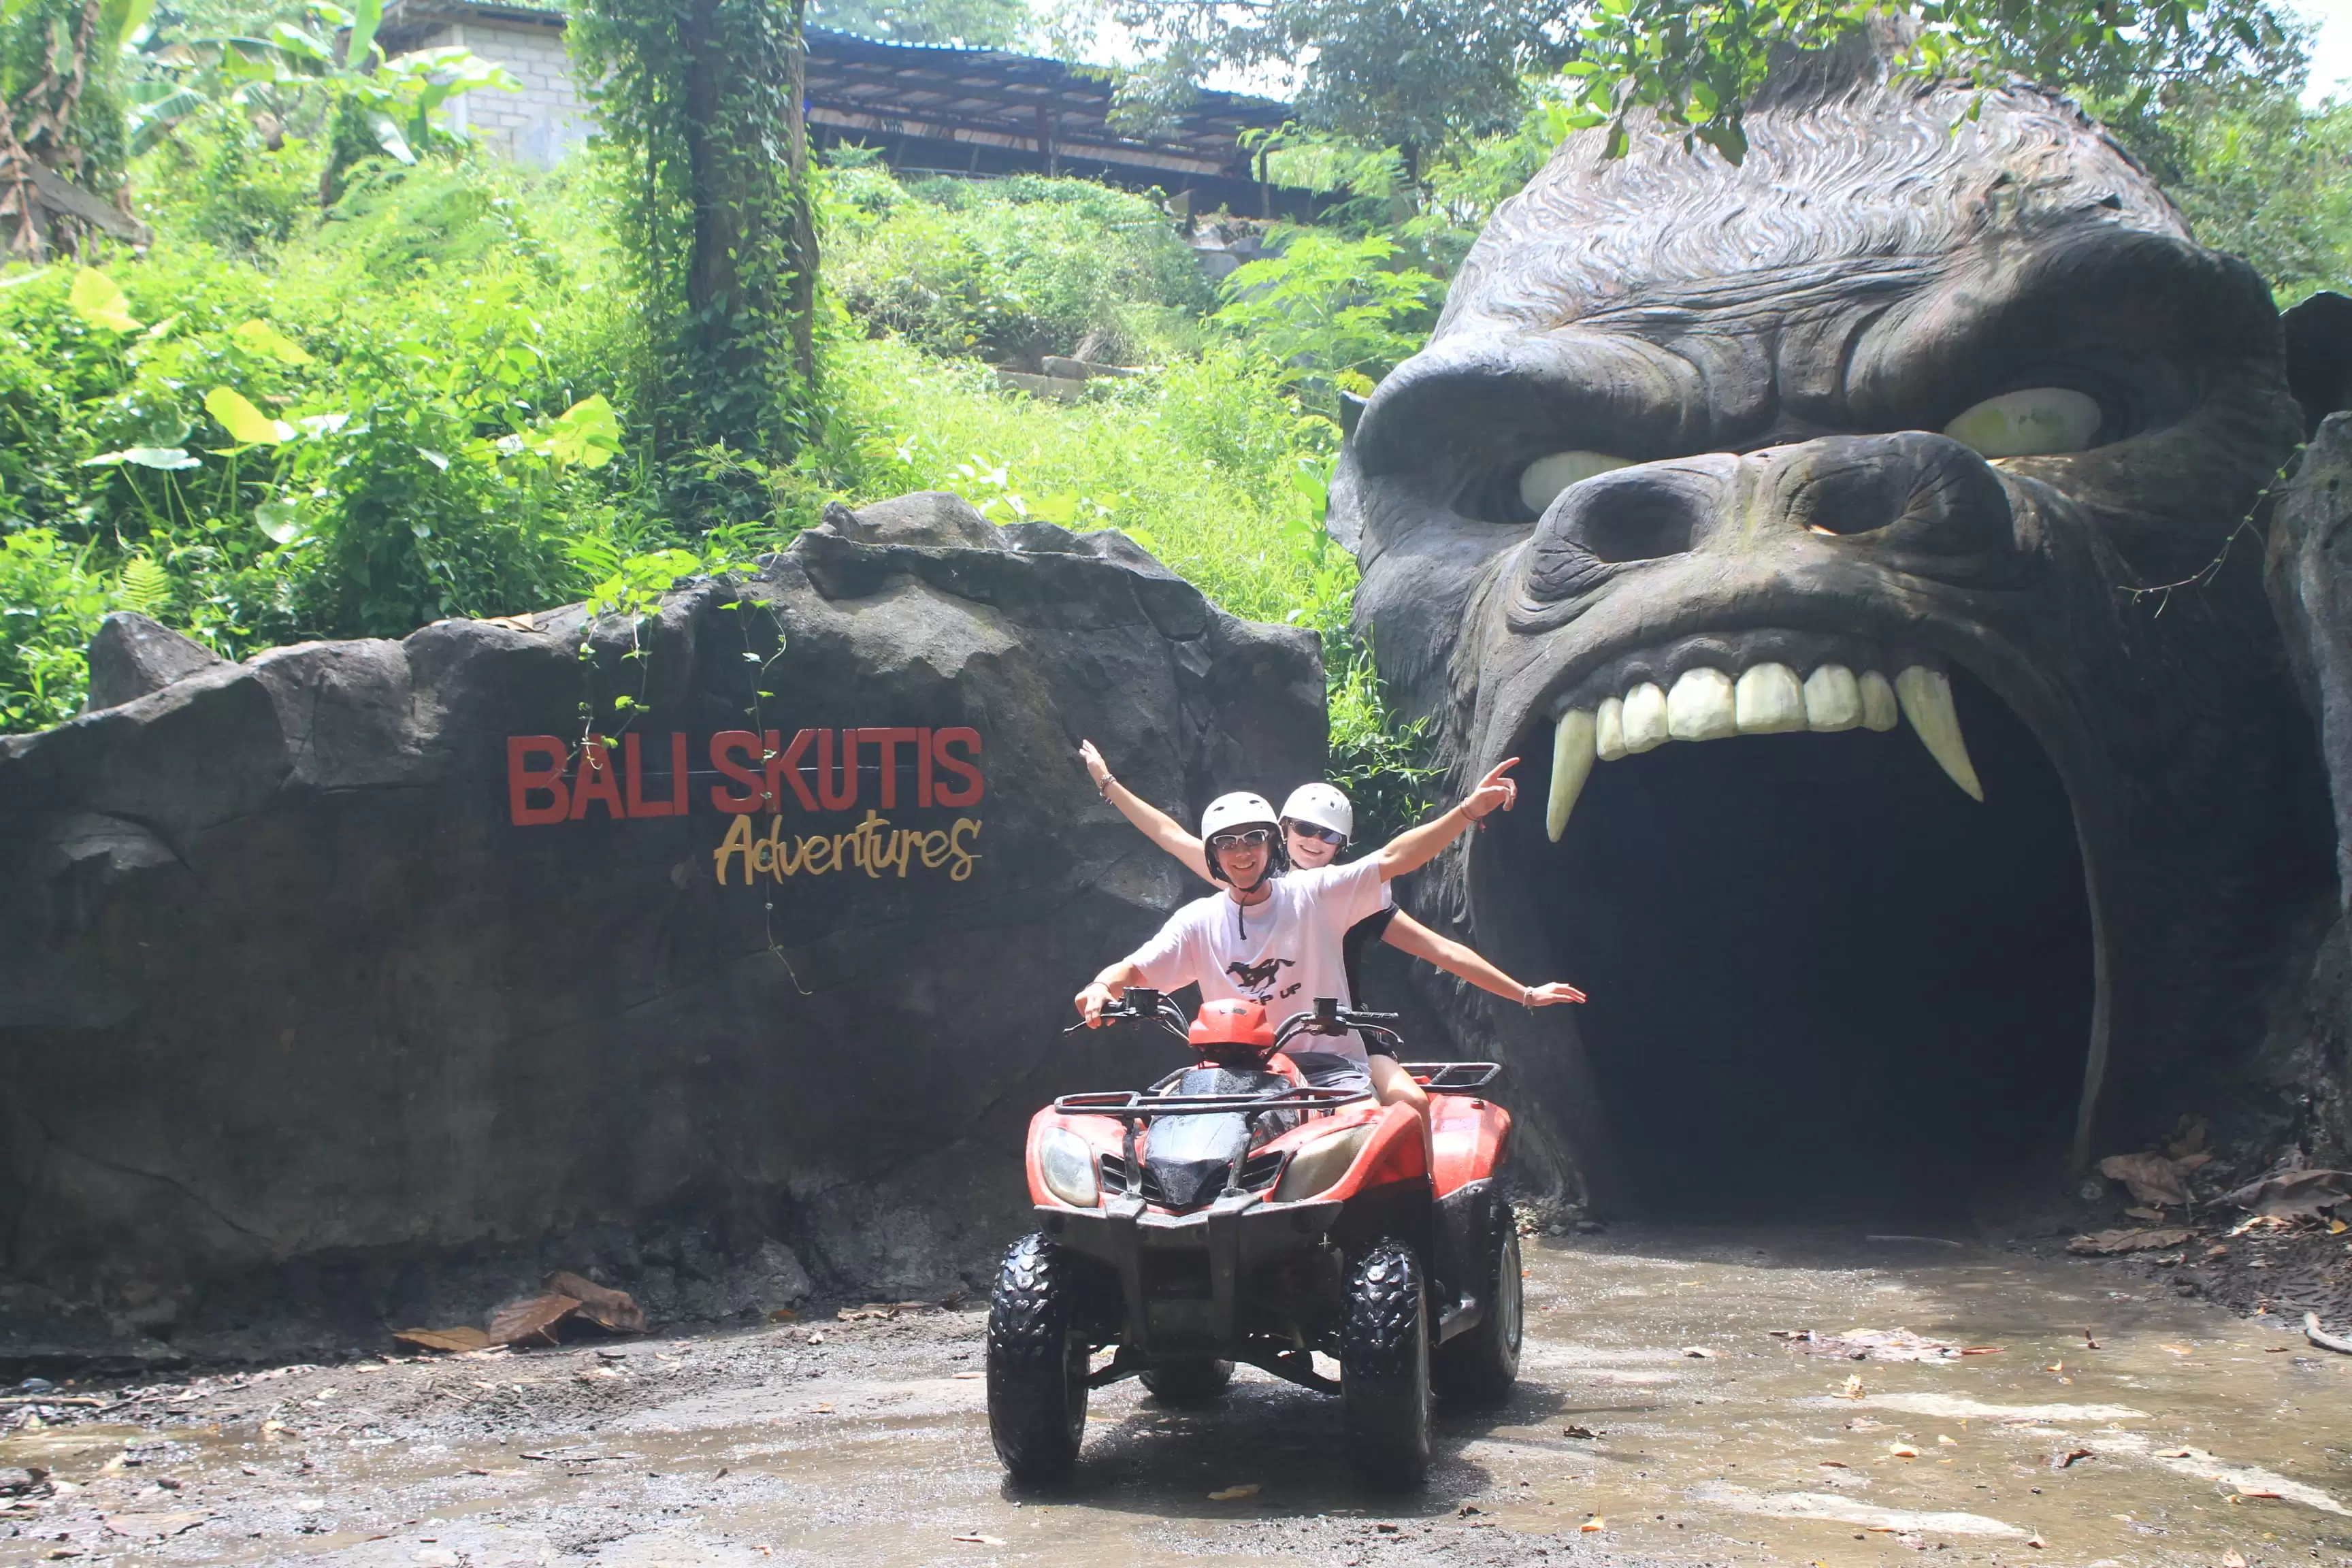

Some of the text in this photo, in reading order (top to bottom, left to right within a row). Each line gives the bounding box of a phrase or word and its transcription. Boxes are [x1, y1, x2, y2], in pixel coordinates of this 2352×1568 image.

[508, 727, 984, 826] BALI SKUTIS
[713, 809, 982, 885] Adventures
[1279, 982, 1301, 999] UP
